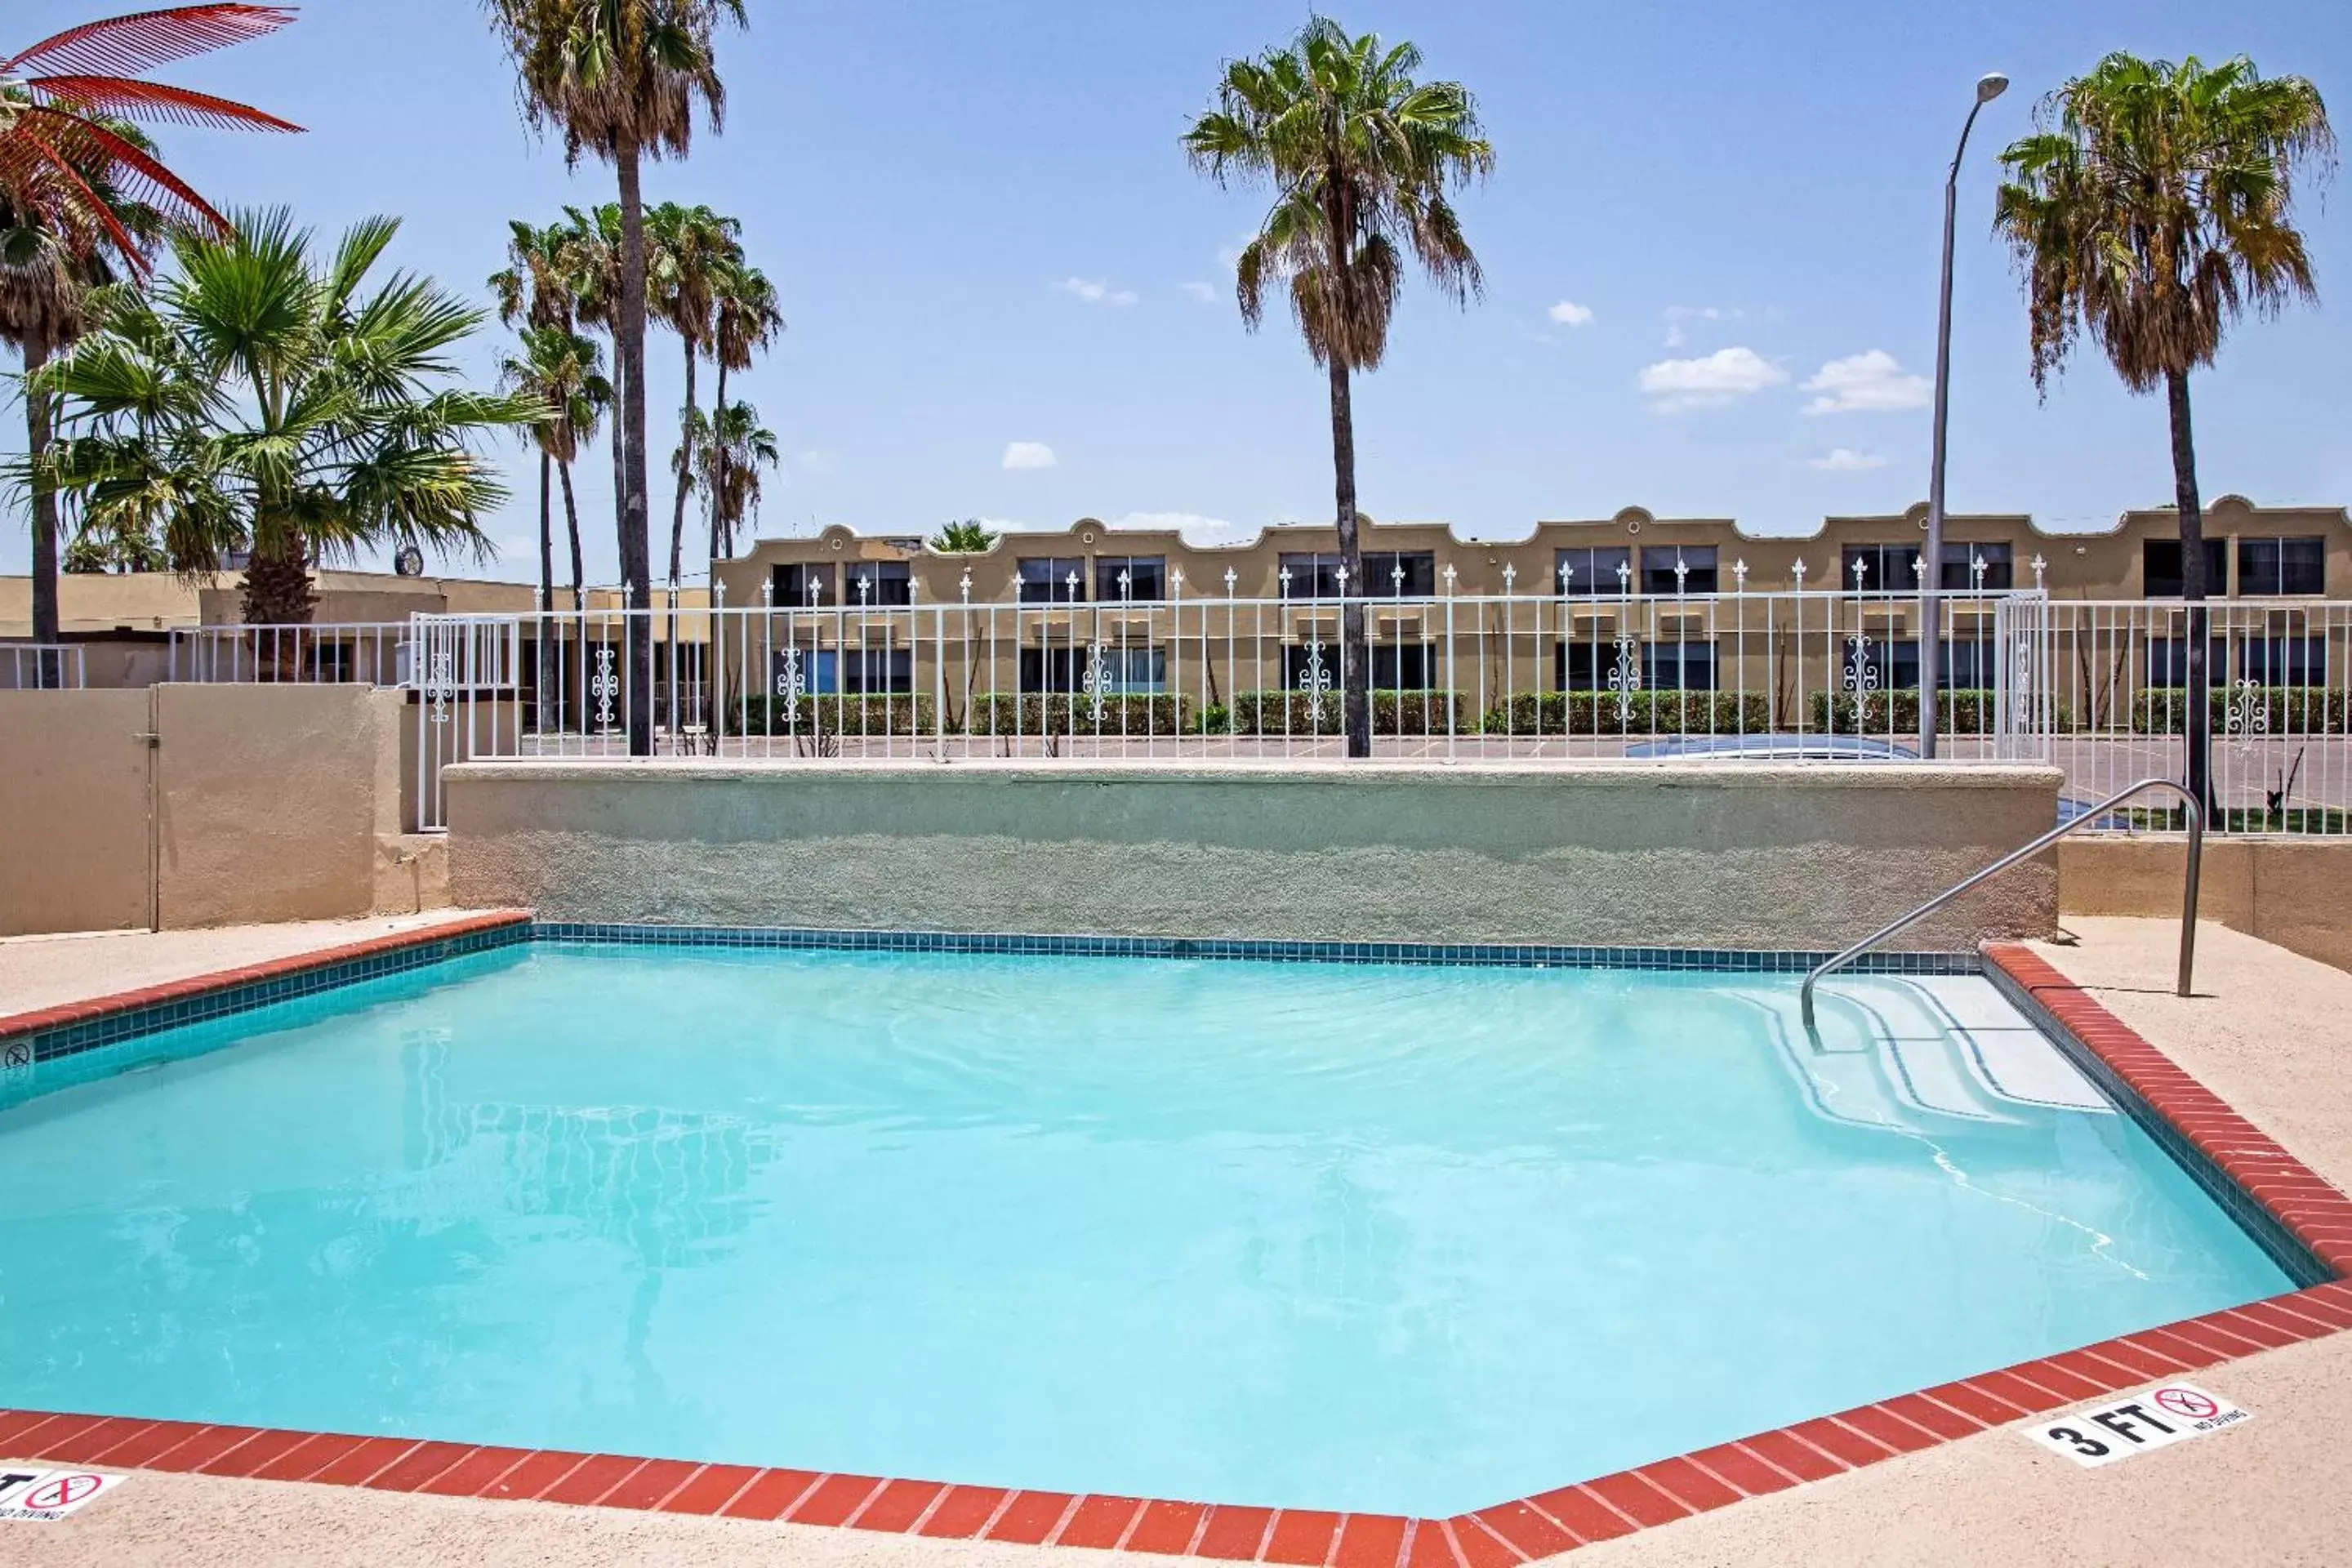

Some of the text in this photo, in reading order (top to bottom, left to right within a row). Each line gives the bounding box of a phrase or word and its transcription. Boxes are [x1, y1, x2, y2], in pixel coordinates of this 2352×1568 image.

[2048, 1404, 2177, 1457] 3 FT
[0, 1473, 38, 1492] T
